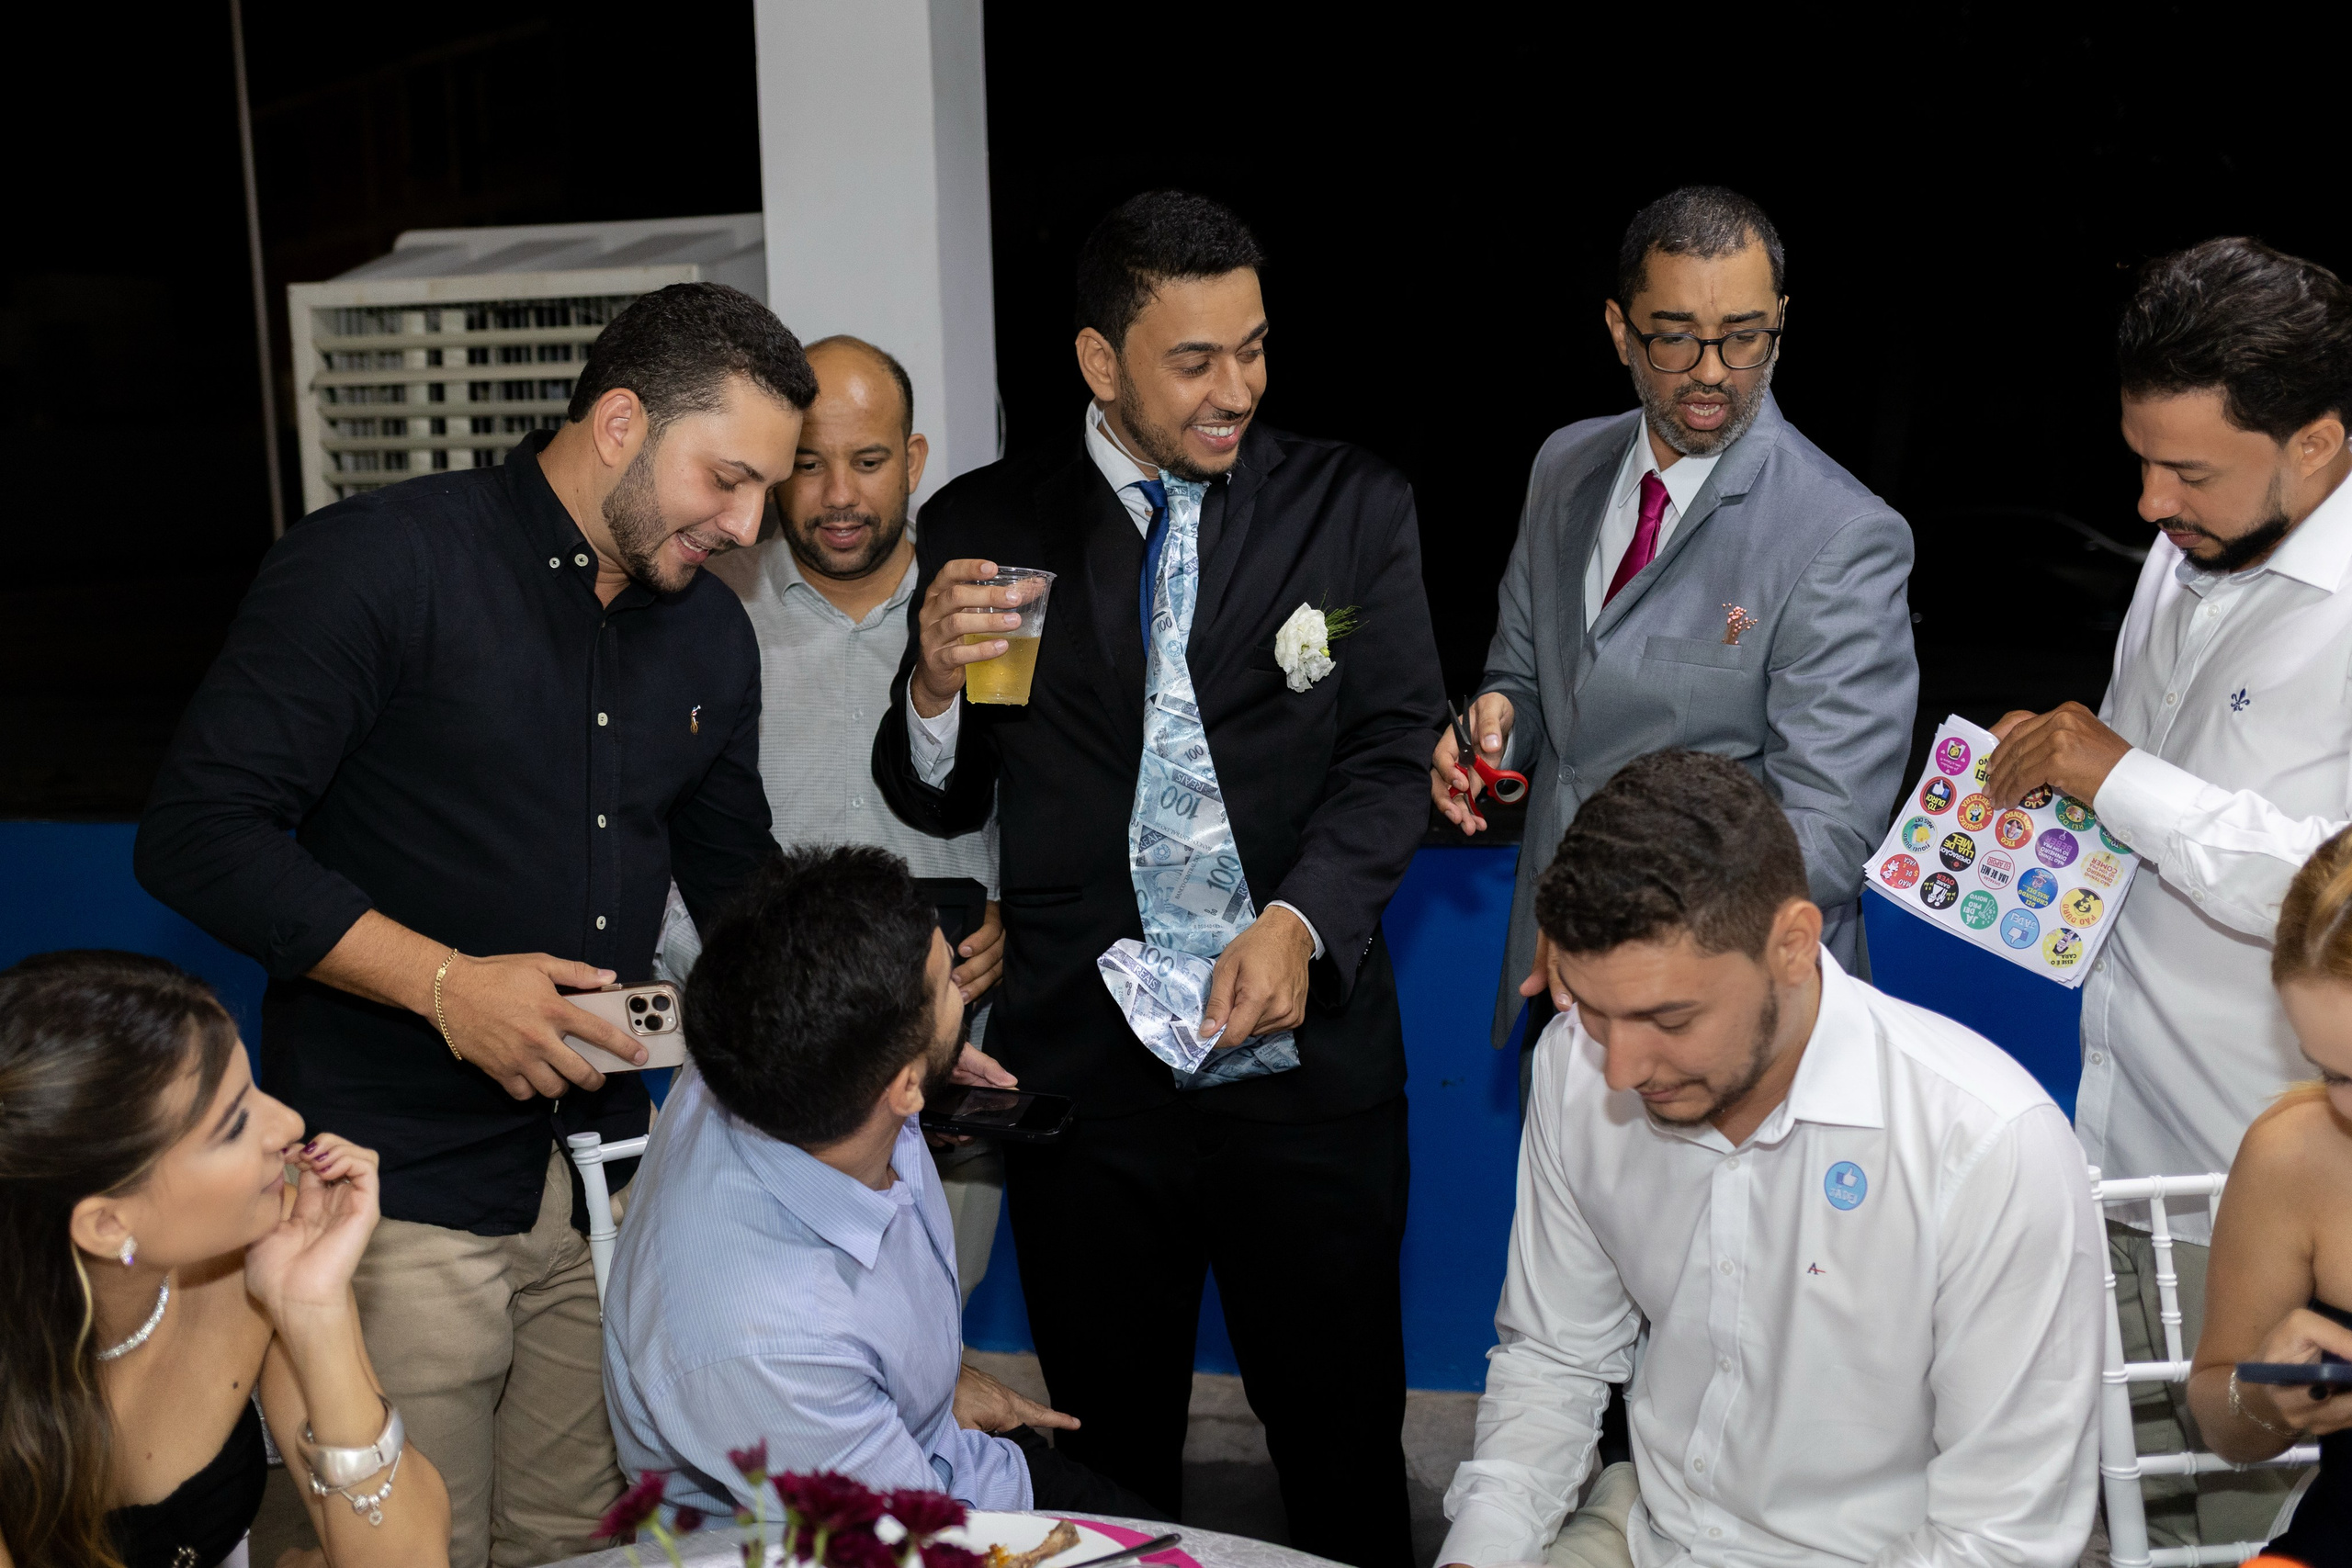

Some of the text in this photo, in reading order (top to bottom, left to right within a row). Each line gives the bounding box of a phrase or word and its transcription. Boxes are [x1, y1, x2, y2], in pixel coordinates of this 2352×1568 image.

[1157, 616, 1173, 633] 100
[1184, 745, 1204, 761] 100
[1176, 773, 1204, 792] REAIS
[1160, 785, 1204, 819] 100
[2059, 814, 2069, 825] DO
[1944, 840, 1974, 858] LUA DE
[1952, 833, 1973, 849] MEL
[2046, 836, 2073, 852] BEBER
[2041, 846, 2067, 861] DINHEIRO
[2091, 857, 2118, 874] COMER
[1206, 855, 1241, 894] 100
[1937, 873, 1955, 886] OVER
[1936, 880, 1951, 889] GAME
[1968, 901, 1982, 909] PRO
[1970, 894, 1988, 903] NOIVO
[2025, 899, 2036, 908] DEI
[1965, 914, 1978, 925] JÁ
[2009, 912, 2023, 924] DEI
[2062, 904, 2097, 925] PÃO DURO
[1138, 943, 1174, 977] 100
[1133, 964, 1159, 989] REAIS
